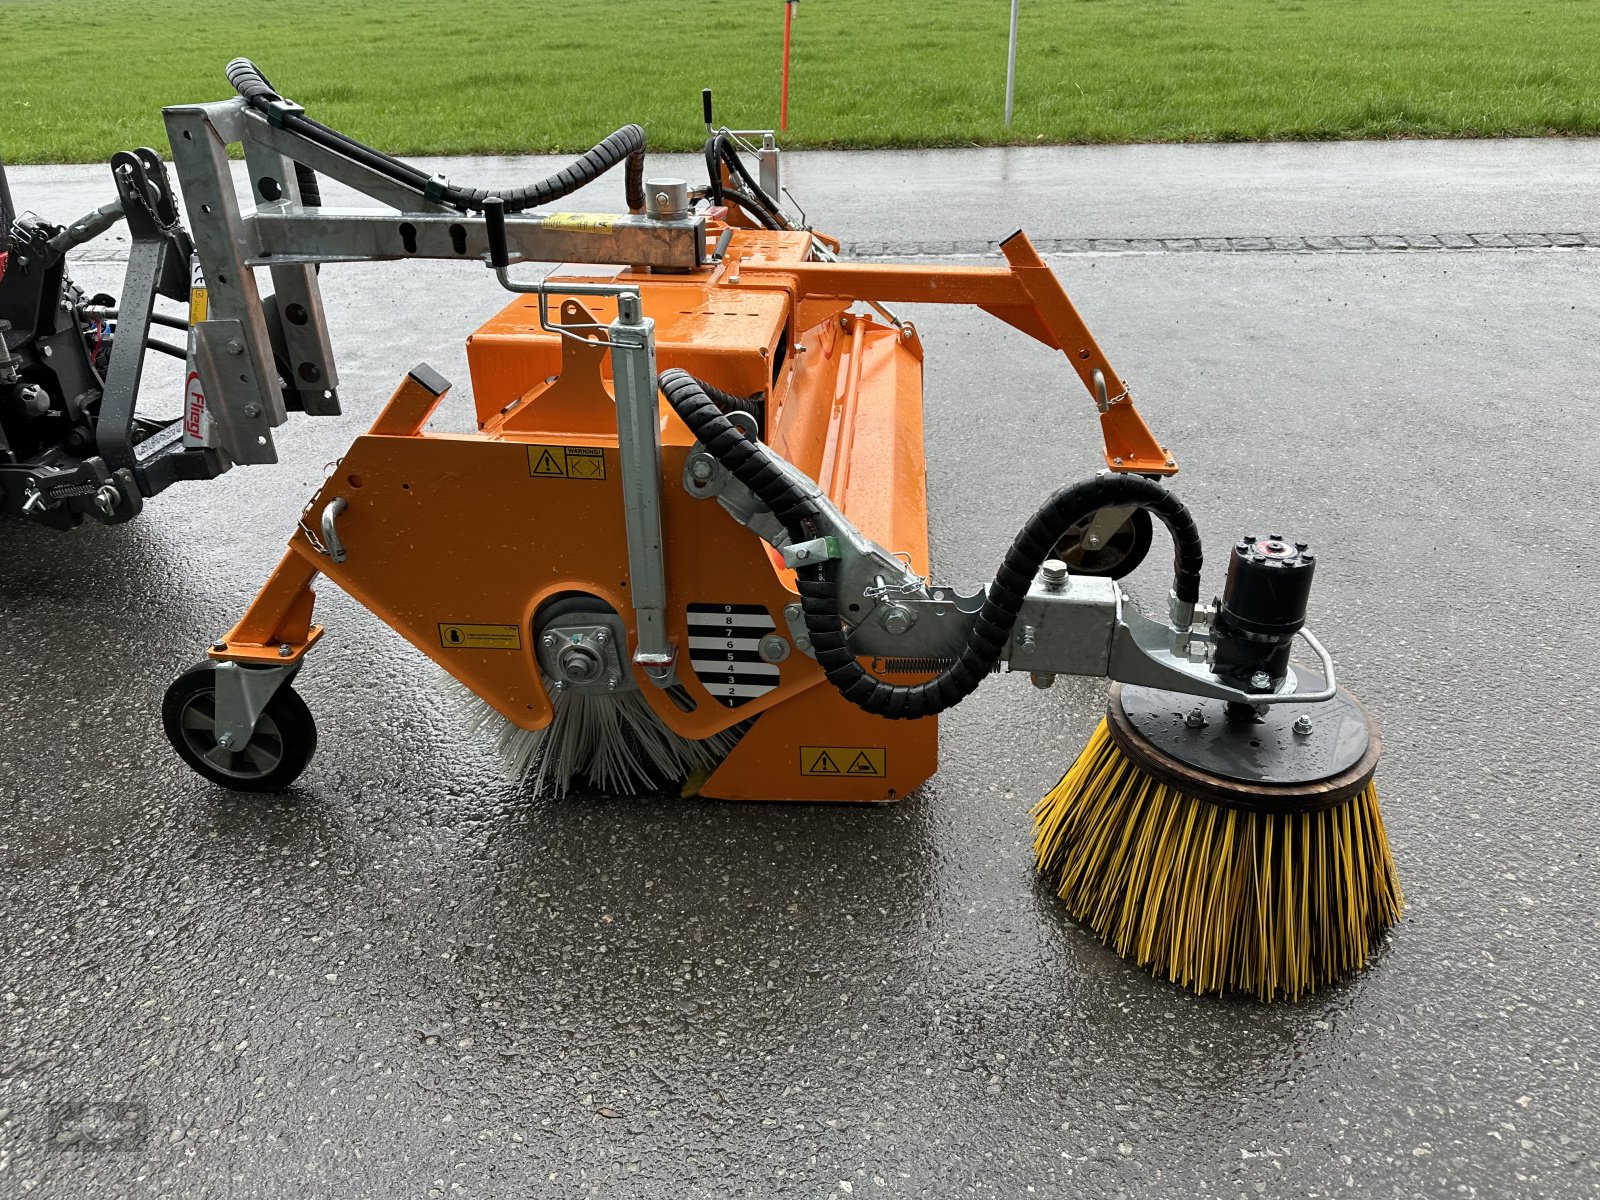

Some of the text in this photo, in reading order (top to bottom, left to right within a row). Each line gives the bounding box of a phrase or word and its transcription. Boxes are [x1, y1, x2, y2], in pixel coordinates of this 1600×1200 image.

[186, 391, 205, 440] Fliegl
[725, 605, 732, 613] 9
[725, 617, 733, 625] 8
[725, 629, 732, 637] 7
[726, 641, 734, 649] 6
[728, 676, 735, 684] 3
[728, 699, 733, 707] 1
